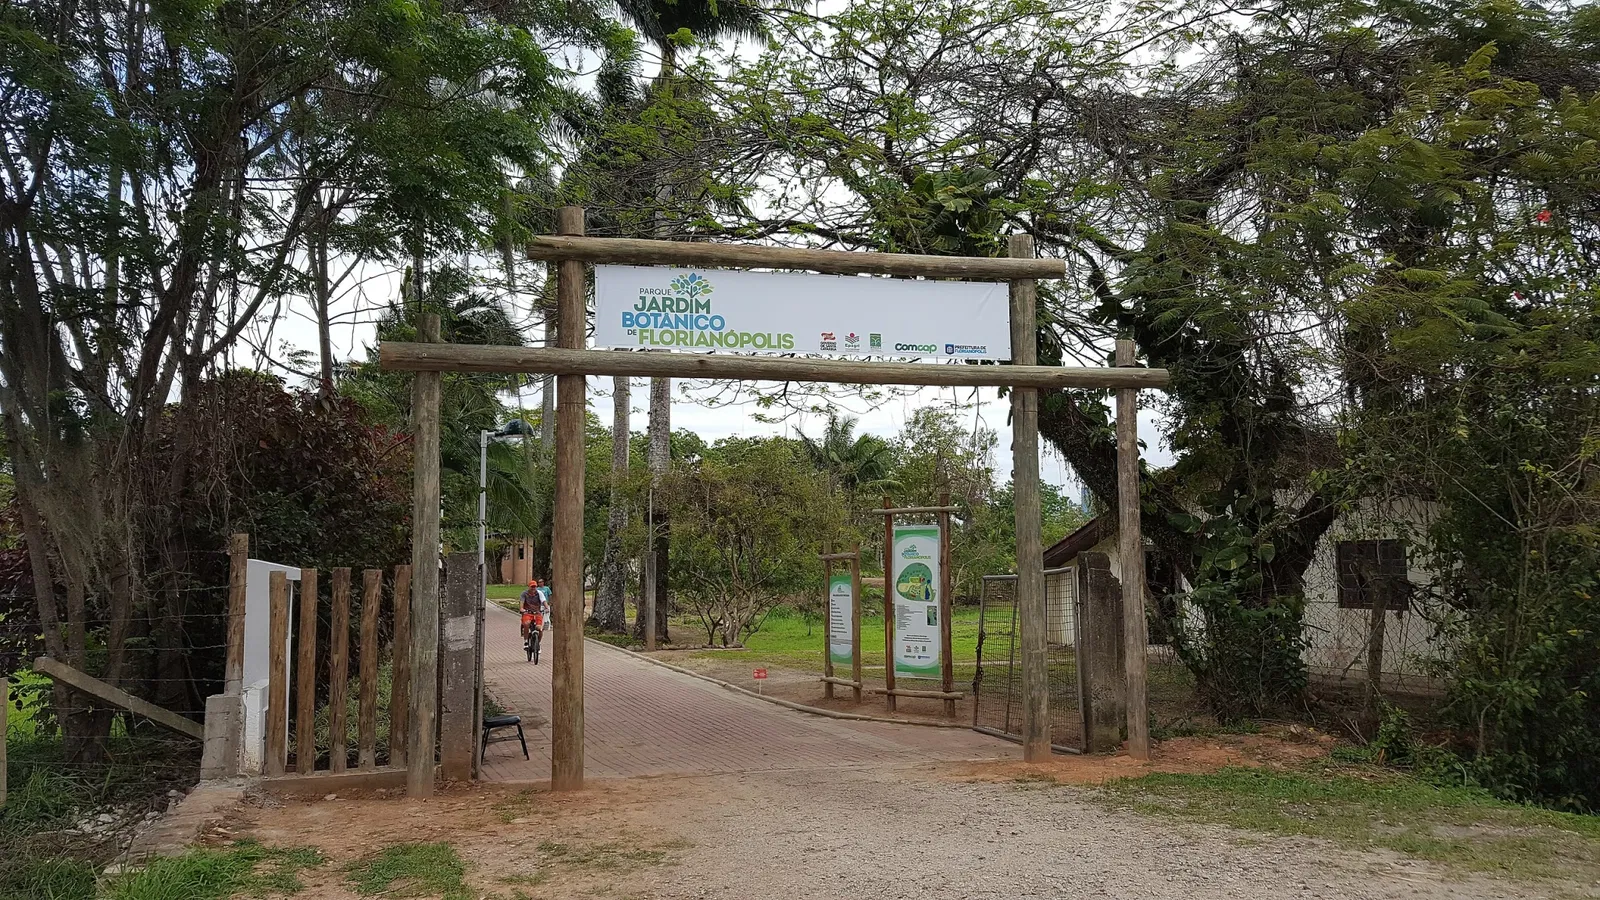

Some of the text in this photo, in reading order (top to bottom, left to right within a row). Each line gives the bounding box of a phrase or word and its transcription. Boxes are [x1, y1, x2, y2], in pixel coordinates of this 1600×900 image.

[639, 287, 672, 296] PARQUE
[633, 296, 711, 315] JARDIM
[621, 311, 726, 332] BOTÂNICO
[627, 328, 795, 350] DE FLORIANÓPOLIS
